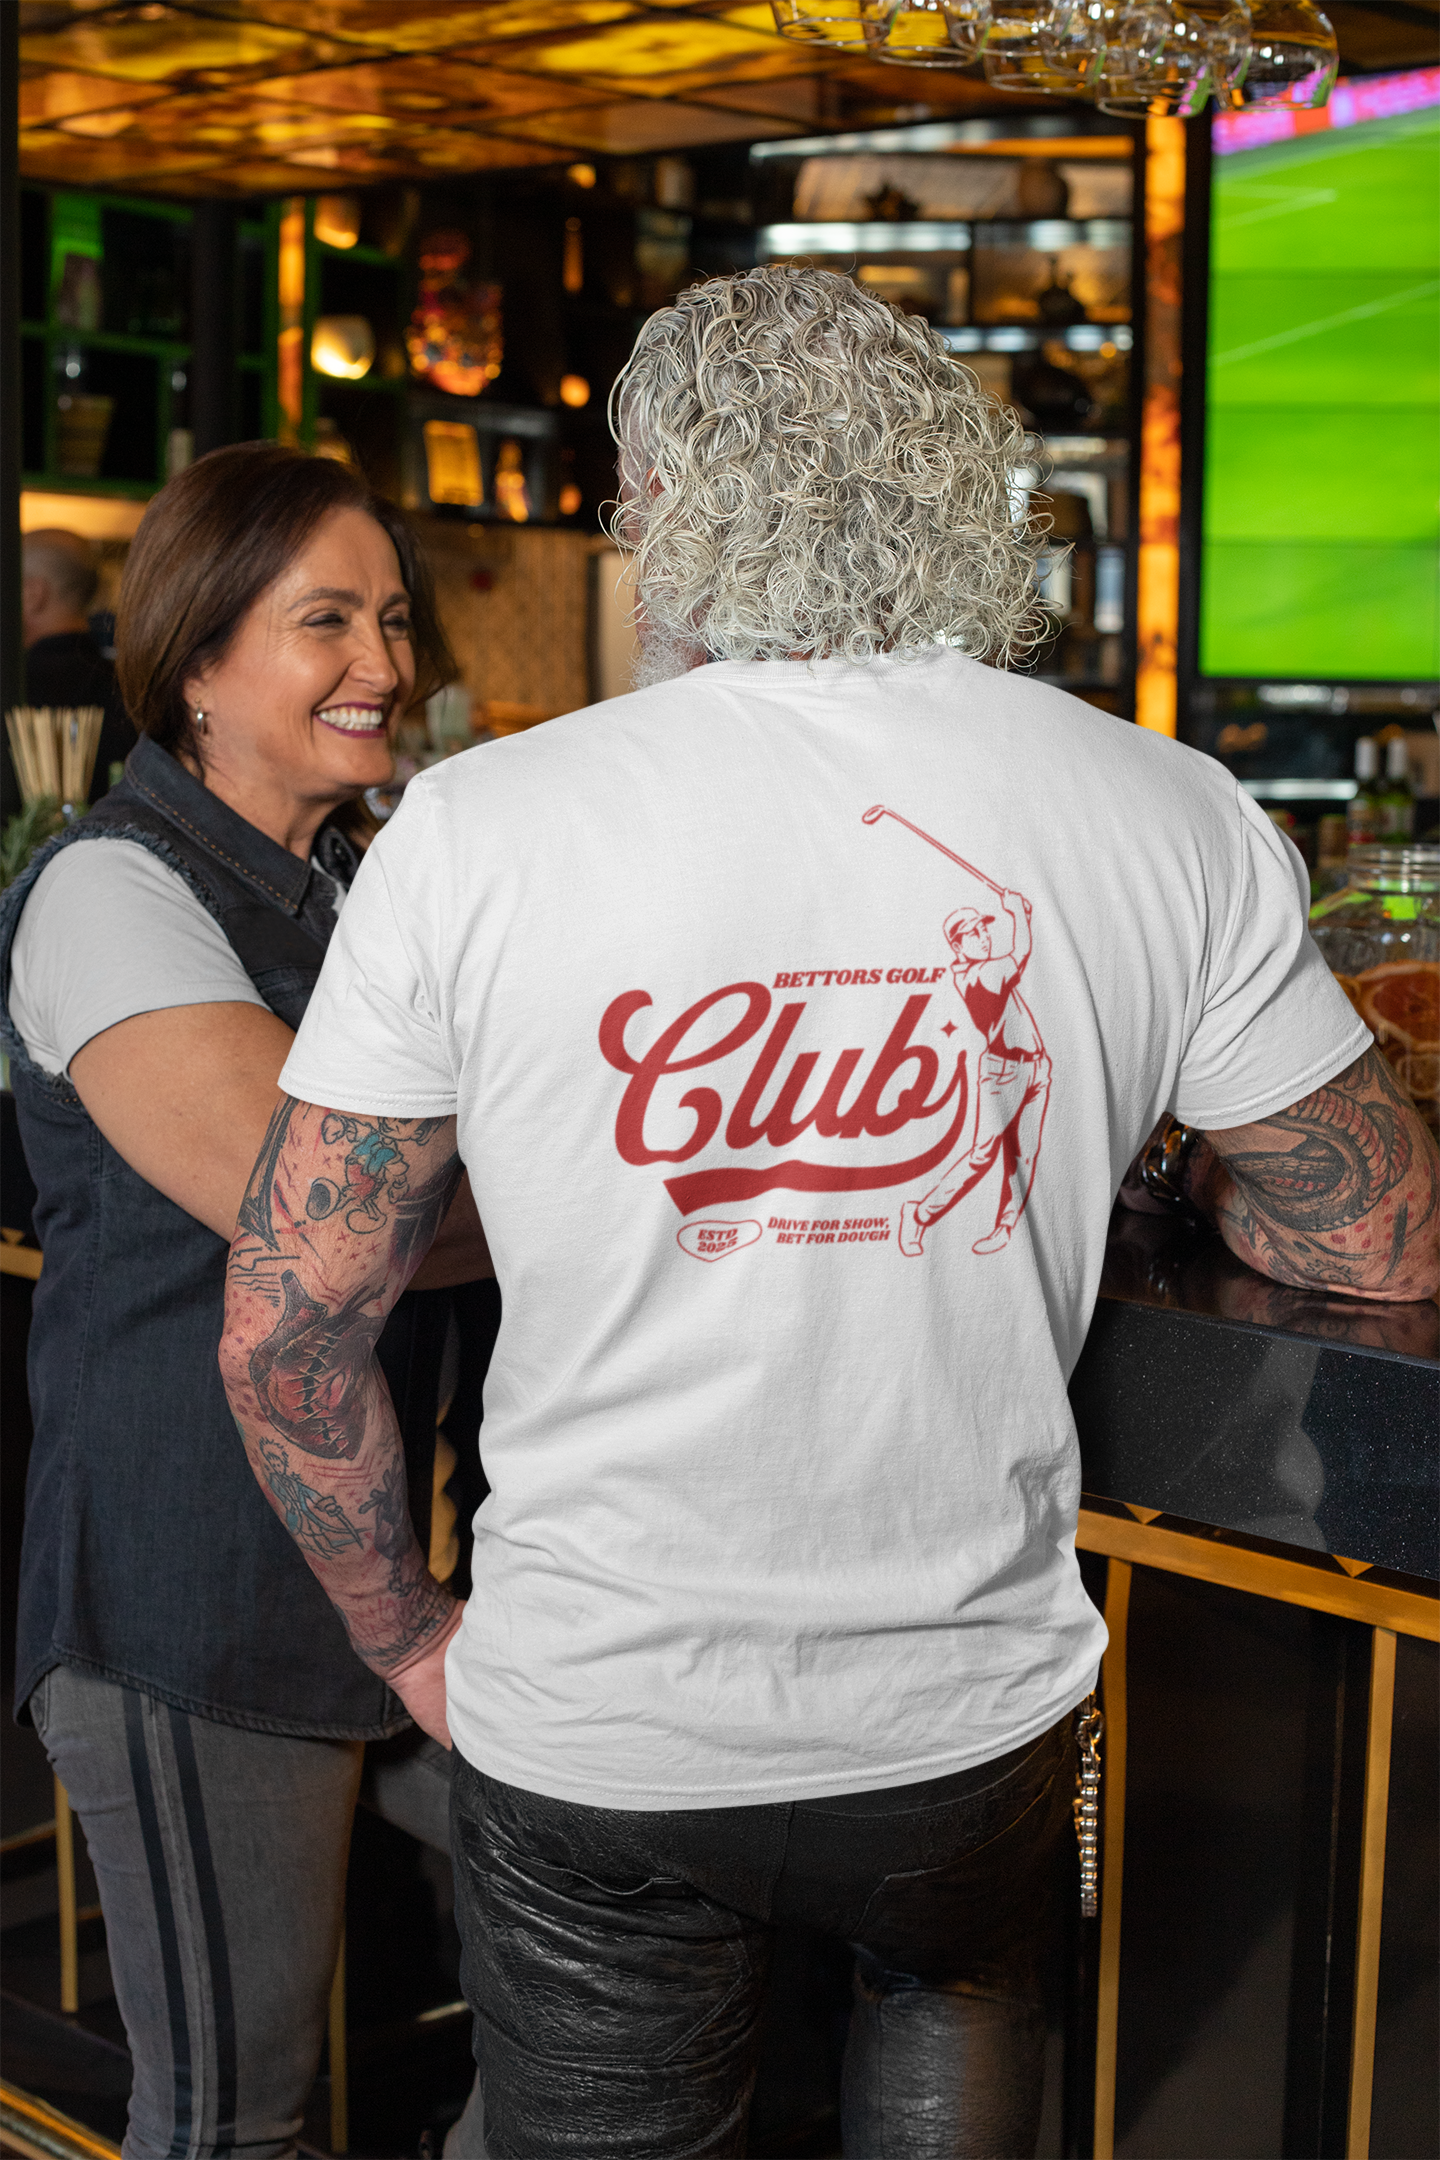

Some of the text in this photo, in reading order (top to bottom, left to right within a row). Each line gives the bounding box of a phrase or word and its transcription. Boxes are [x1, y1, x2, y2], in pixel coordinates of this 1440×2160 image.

[772, 967, 947, 989] BETTORS GOLF
[598, 981, 968, 1167] Club
[767, 1216, 890, 1231] DRIVE FOR SHOW,
[697, 1228, 738, 1241] ESTD
[776, 1229, 891, 1244] BET FOR DOUGH
[697, 1236, 738, 1253] 2025
